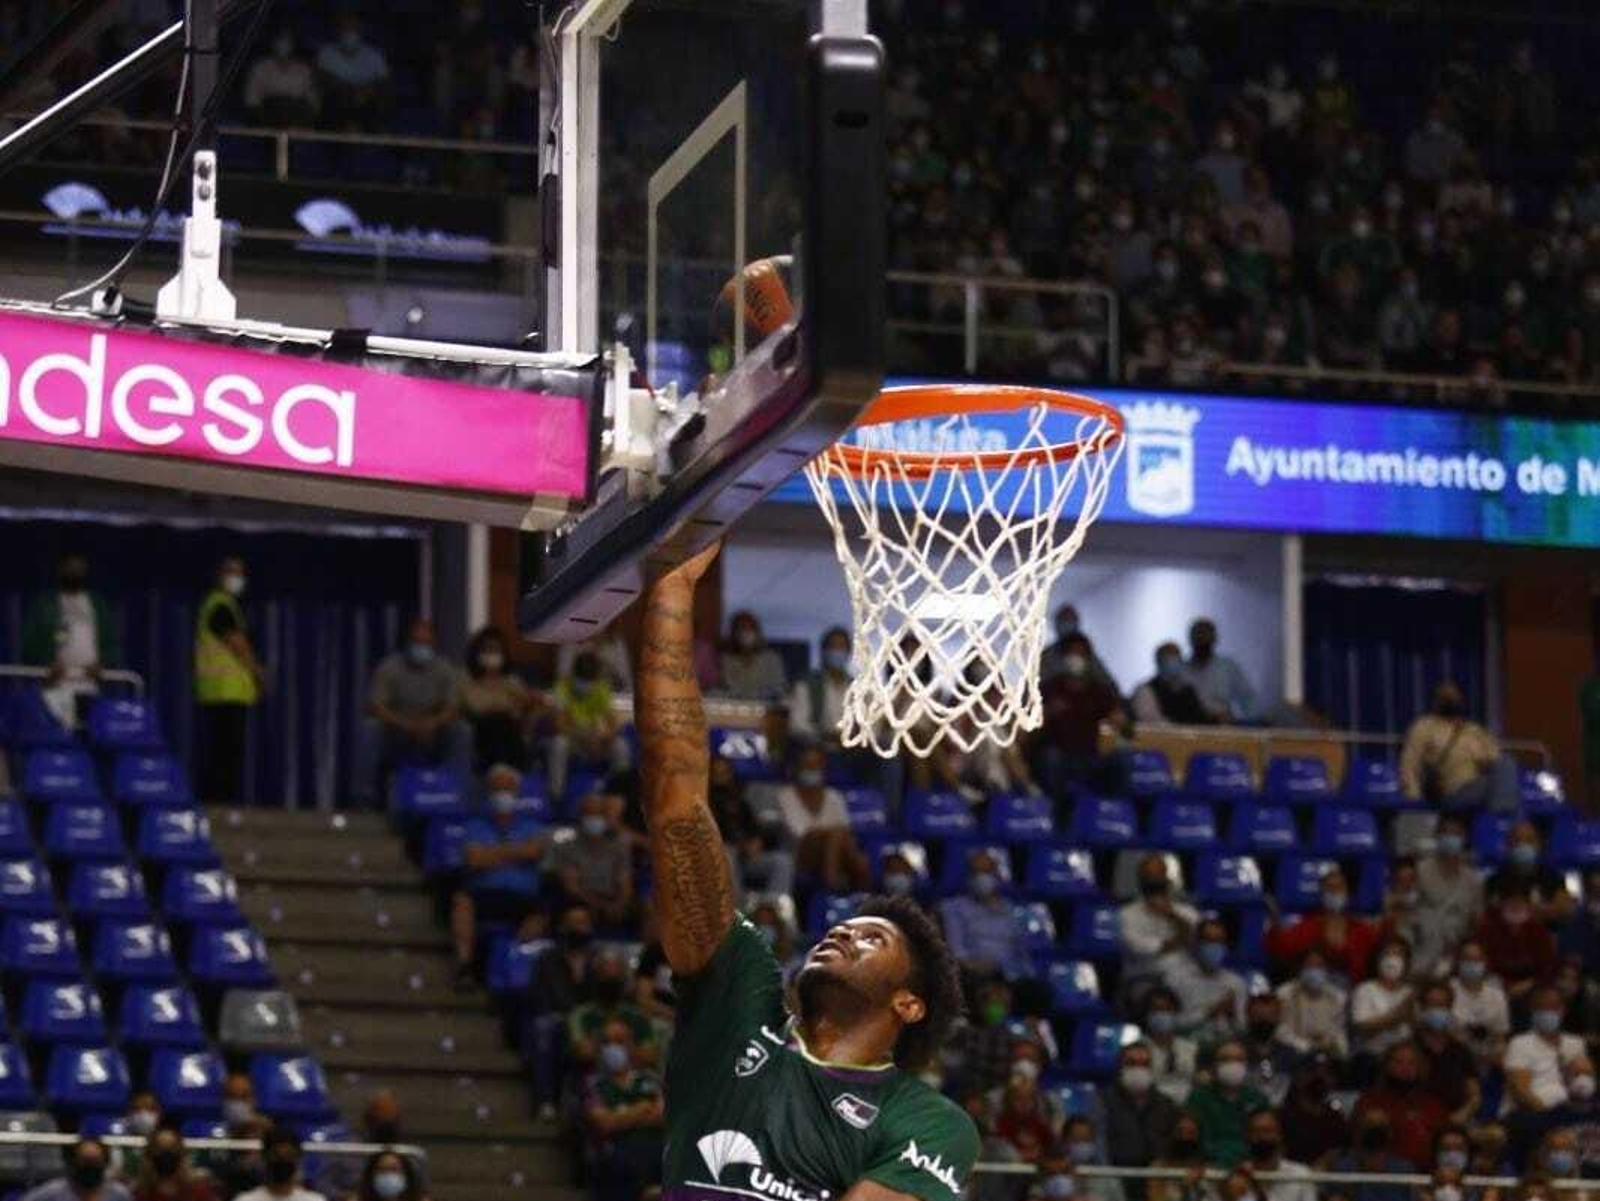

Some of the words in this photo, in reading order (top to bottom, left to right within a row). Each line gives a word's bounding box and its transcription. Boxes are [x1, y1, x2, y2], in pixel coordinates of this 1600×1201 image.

[0, 333, 356, 468] desa
[1225, 435, 1506, 491] Ayuntamiento
[1516, 454, 1567, 495] de
